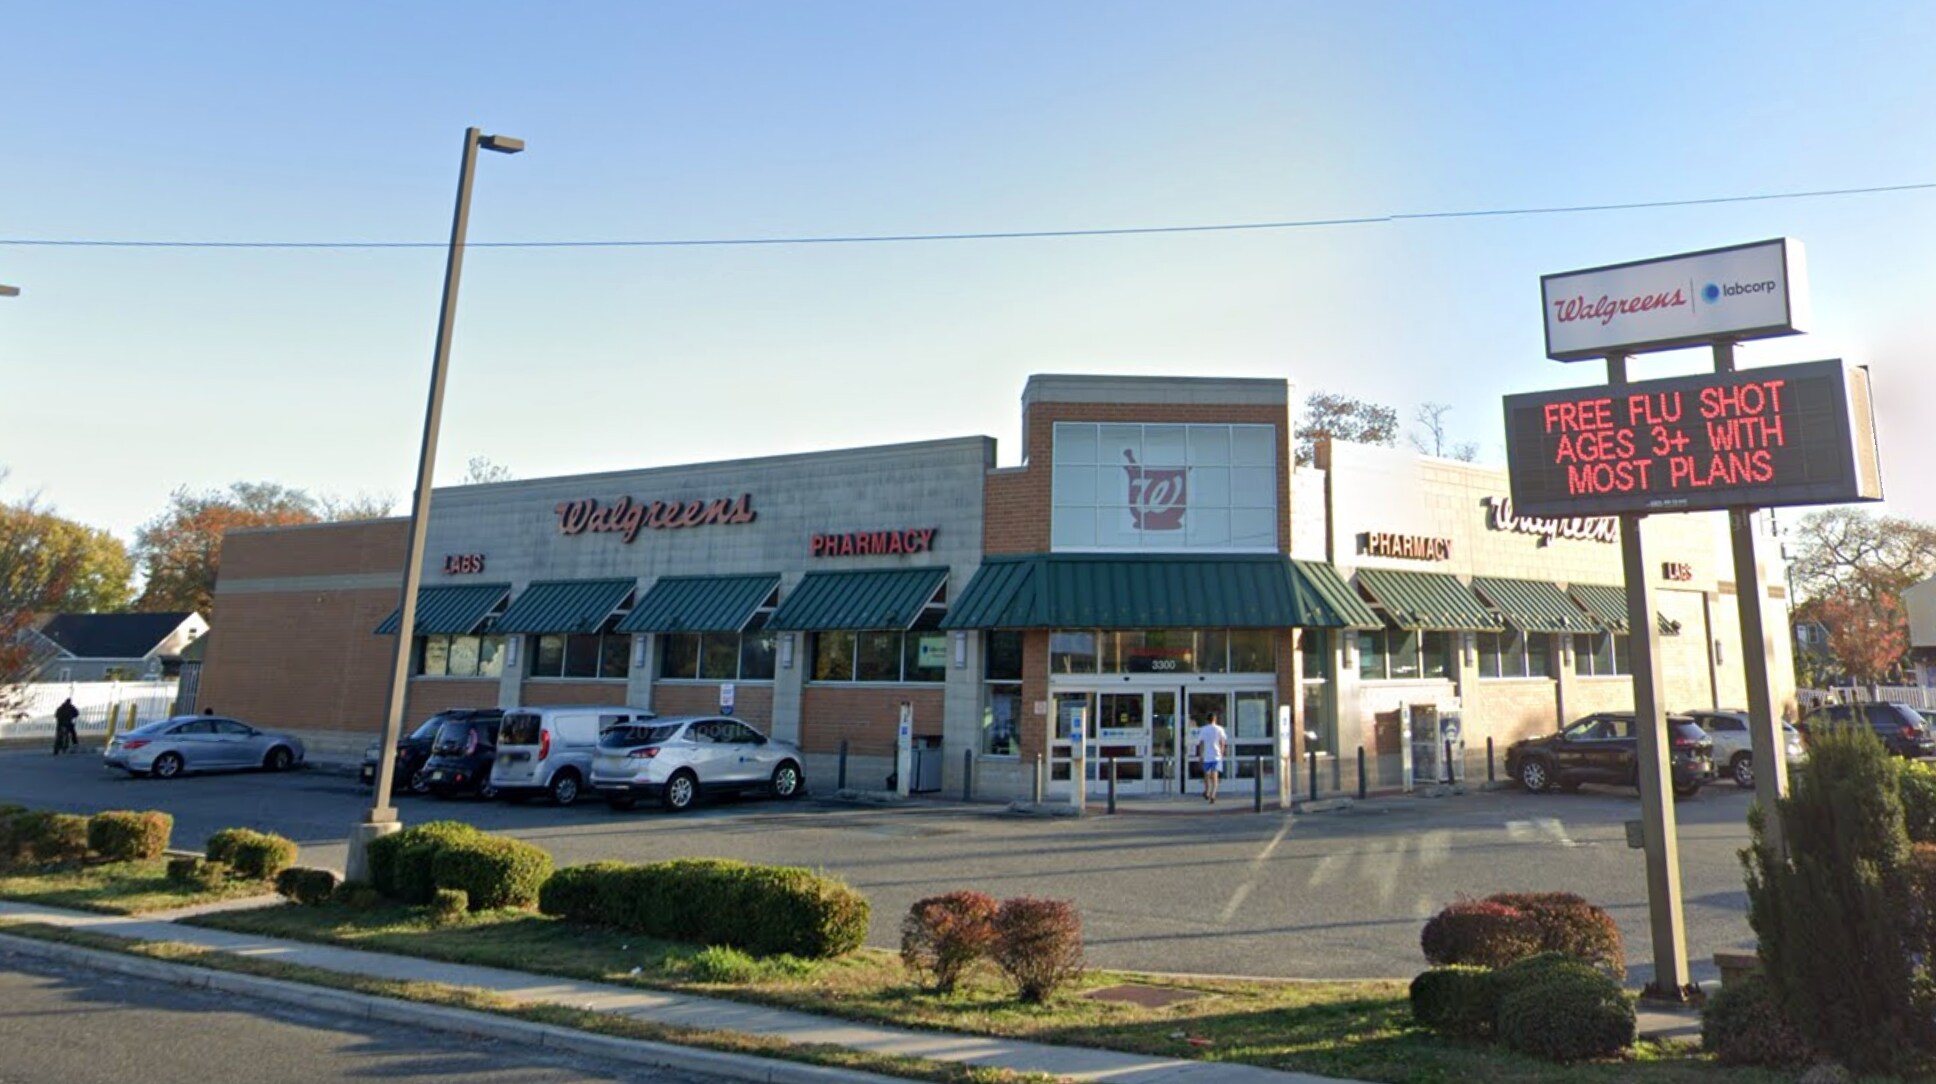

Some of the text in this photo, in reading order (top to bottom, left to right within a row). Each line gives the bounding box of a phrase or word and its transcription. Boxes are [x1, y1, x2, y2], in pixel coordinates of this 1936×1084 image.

[1722, 279, 1776, 298] labcorp
[1554, 288, 1687, 326] Walgreens
[1544, 379, 1785, 434] FREE FLU SHOT
[1555, 415, 1784, 464] AGES 3+ WITH
[1567, 450, 1774, 495] MOST PLANS
[554, 493, 758, 545] Walgreens
[809, 527, 939, 557] PHARMACY
[1360, 531, 1452, 561] PHARMACY
[442, 553, 486, 576] LABS
[1151, 659, 1176, 670] 3300
